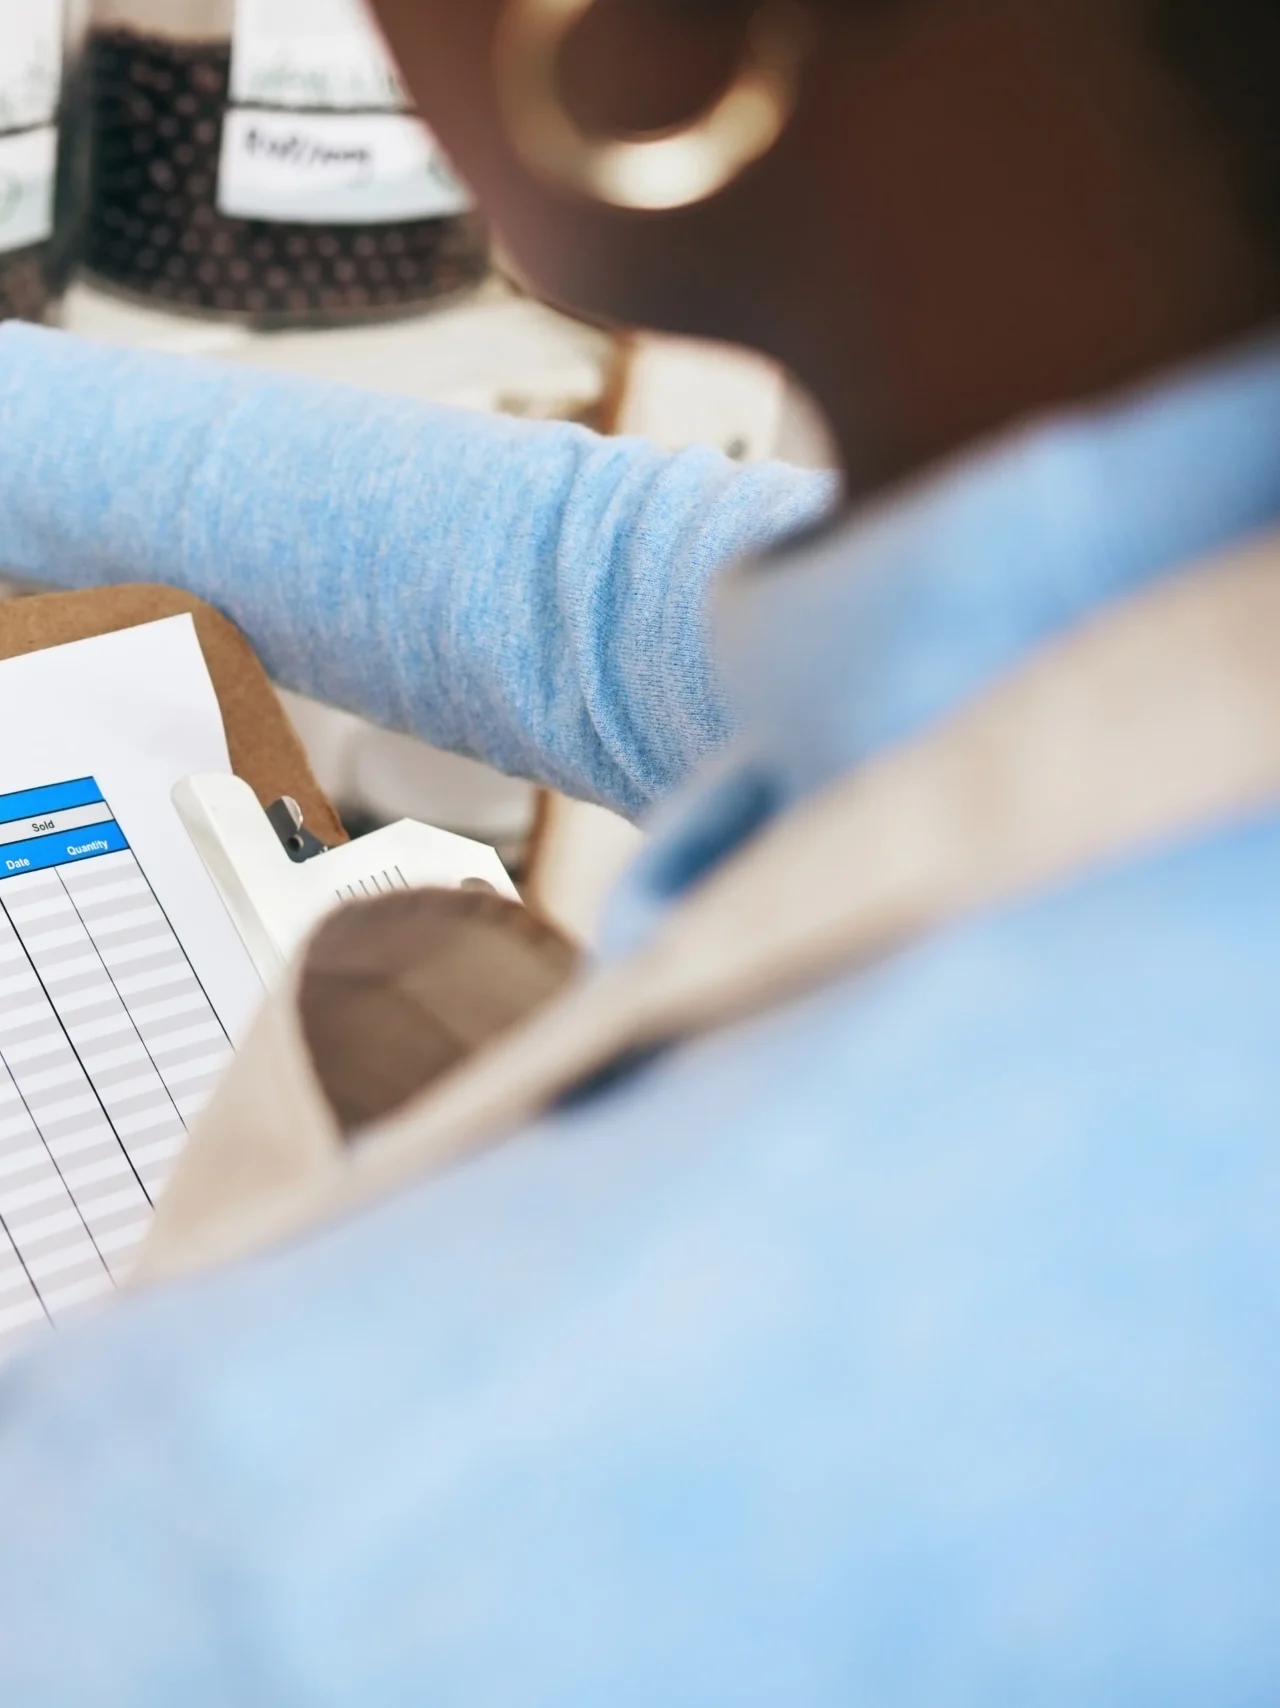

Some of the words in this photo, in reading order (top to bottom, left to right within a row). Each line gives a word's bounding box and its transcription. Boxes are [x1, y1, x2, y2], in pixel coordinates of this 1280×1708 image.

[31, 819, 56, 833] Sold
[66, 839, 109, 857] Quantity
[6, 857, 31, 871] Date
